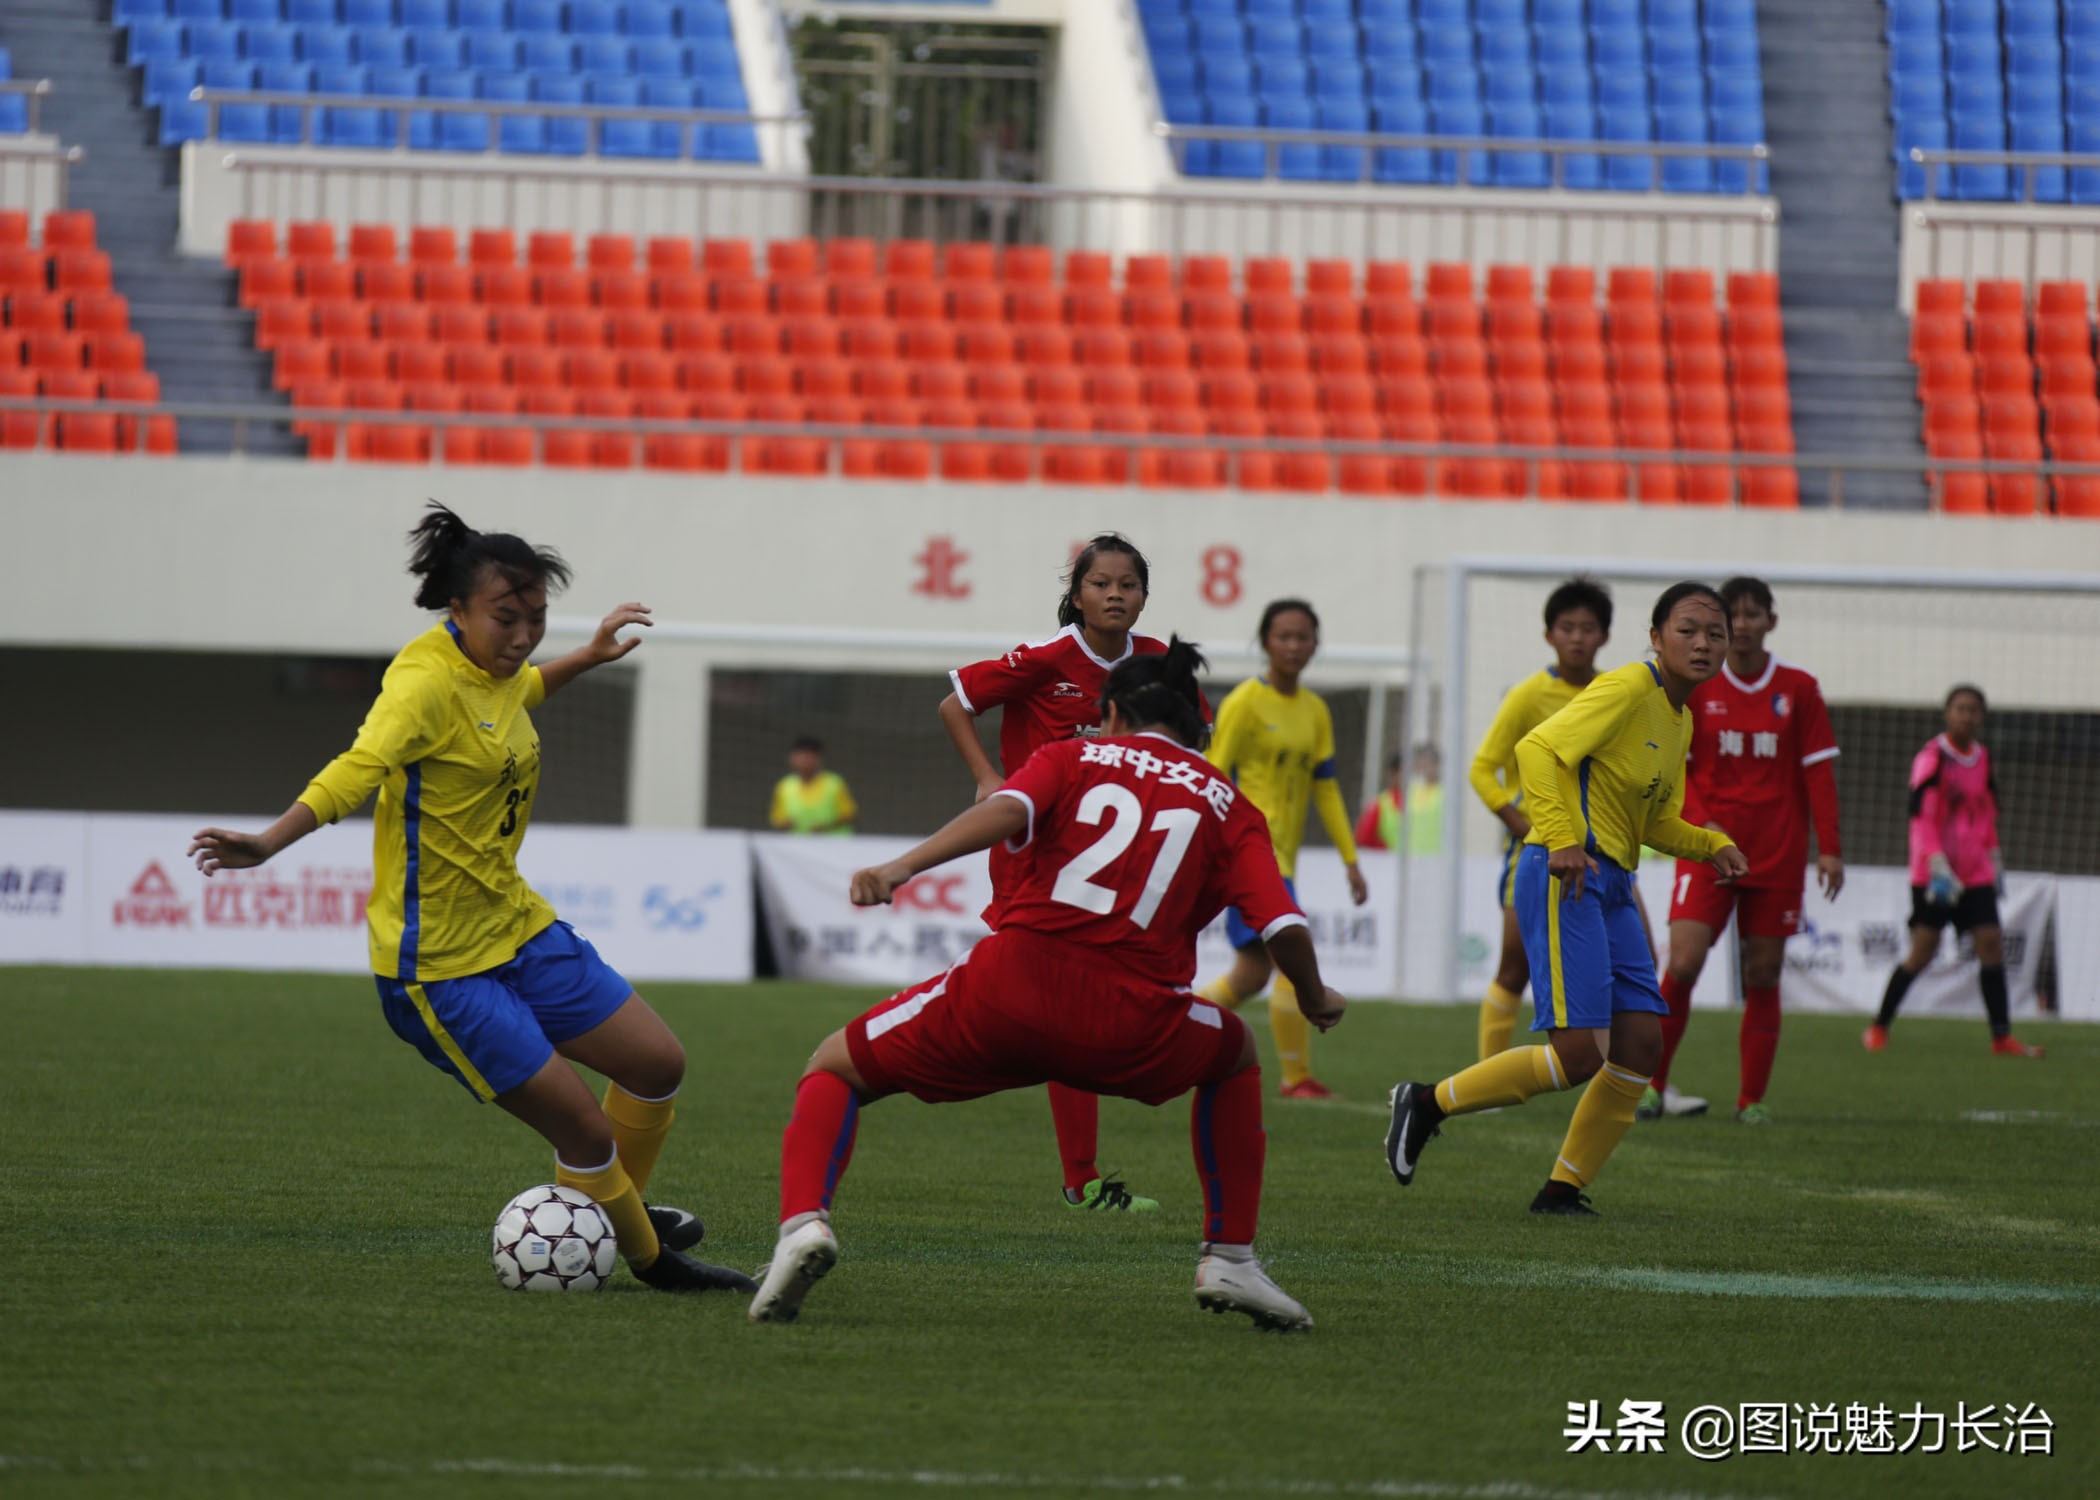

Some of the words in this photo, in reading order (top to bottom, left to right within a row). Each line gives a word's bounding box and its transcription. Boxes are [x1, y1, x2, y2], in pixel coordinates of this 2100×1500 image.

[911, 536, 972, 600] 北
[1201, 545, 1243, 607] 8
[1718, 729, 1778, 759] 海南
[1079, 741, 1236, 822] 琼中女足
[1050, 782, 1202, 931] 21
